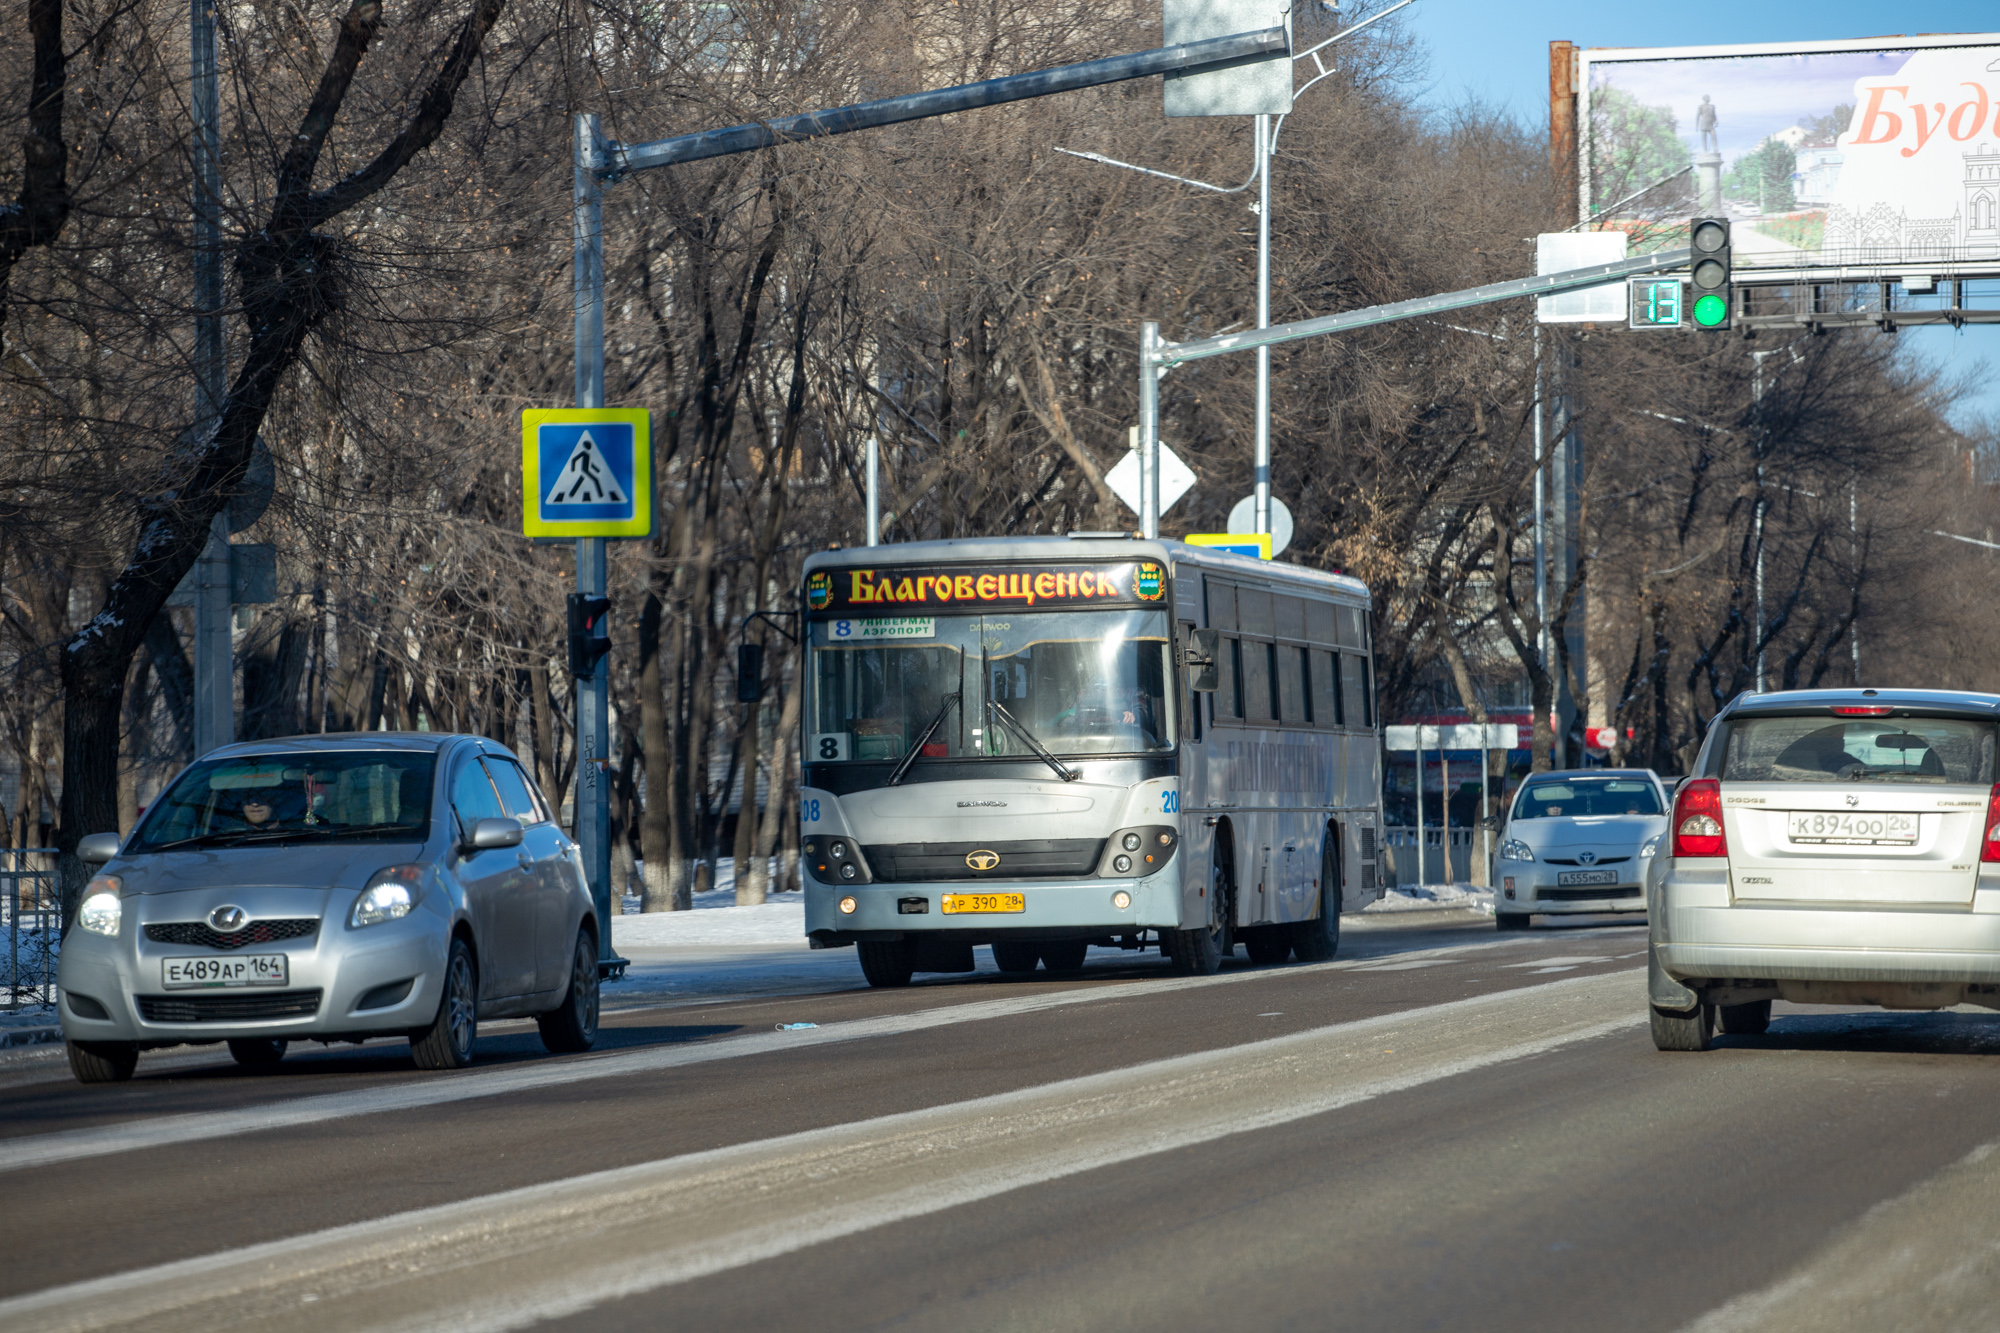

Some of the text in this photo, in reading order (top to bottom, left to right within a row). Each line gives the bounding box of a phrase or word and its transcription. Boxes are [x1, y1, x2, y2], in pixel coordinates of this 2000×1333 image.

[1849, 82, 2000, 158] Буд
[1648, 281, 1679, 323] 13
[835, 620, 852, 637] 8
[863, 626, 930, 636] АЭРОПОРТ
[969, 622, 1011, 632] DAEWOO
[819, 737, 839, 759] 8
[1161, 790, 1181, 814] 20
[972, 896, 998, 910] 390
[1005, 895, 1019, 906] 28
[250, 957, 279, 973] 164
